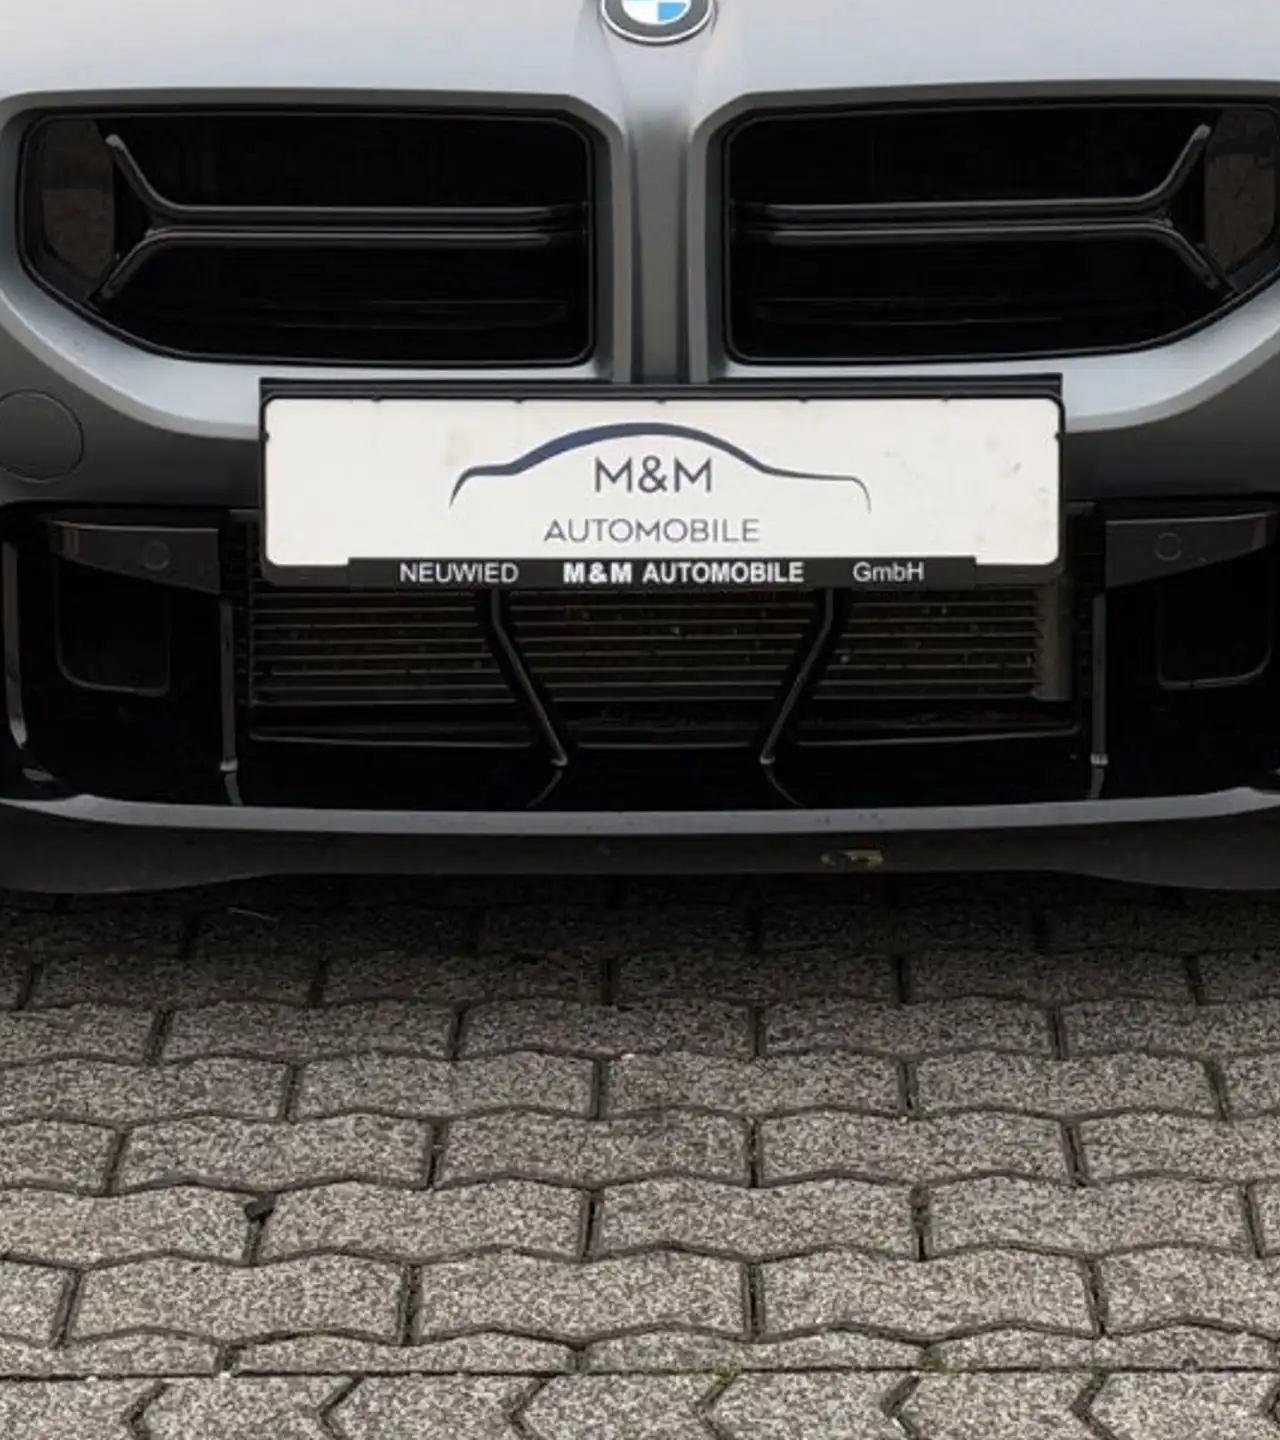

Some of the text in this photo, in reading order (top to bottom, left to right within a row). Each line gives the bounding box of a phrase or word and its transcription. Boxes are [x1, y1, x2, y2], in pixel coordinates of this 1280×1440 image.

[593, 456, 712, 494] M&M
[543, 518, 760, 544] AUTOMOBILE
[399, 561, 519, 584] NEUWIED
[642, 561, 804, 584] AUTOMOBILE
[852, 561, 925, 583] GmbH
